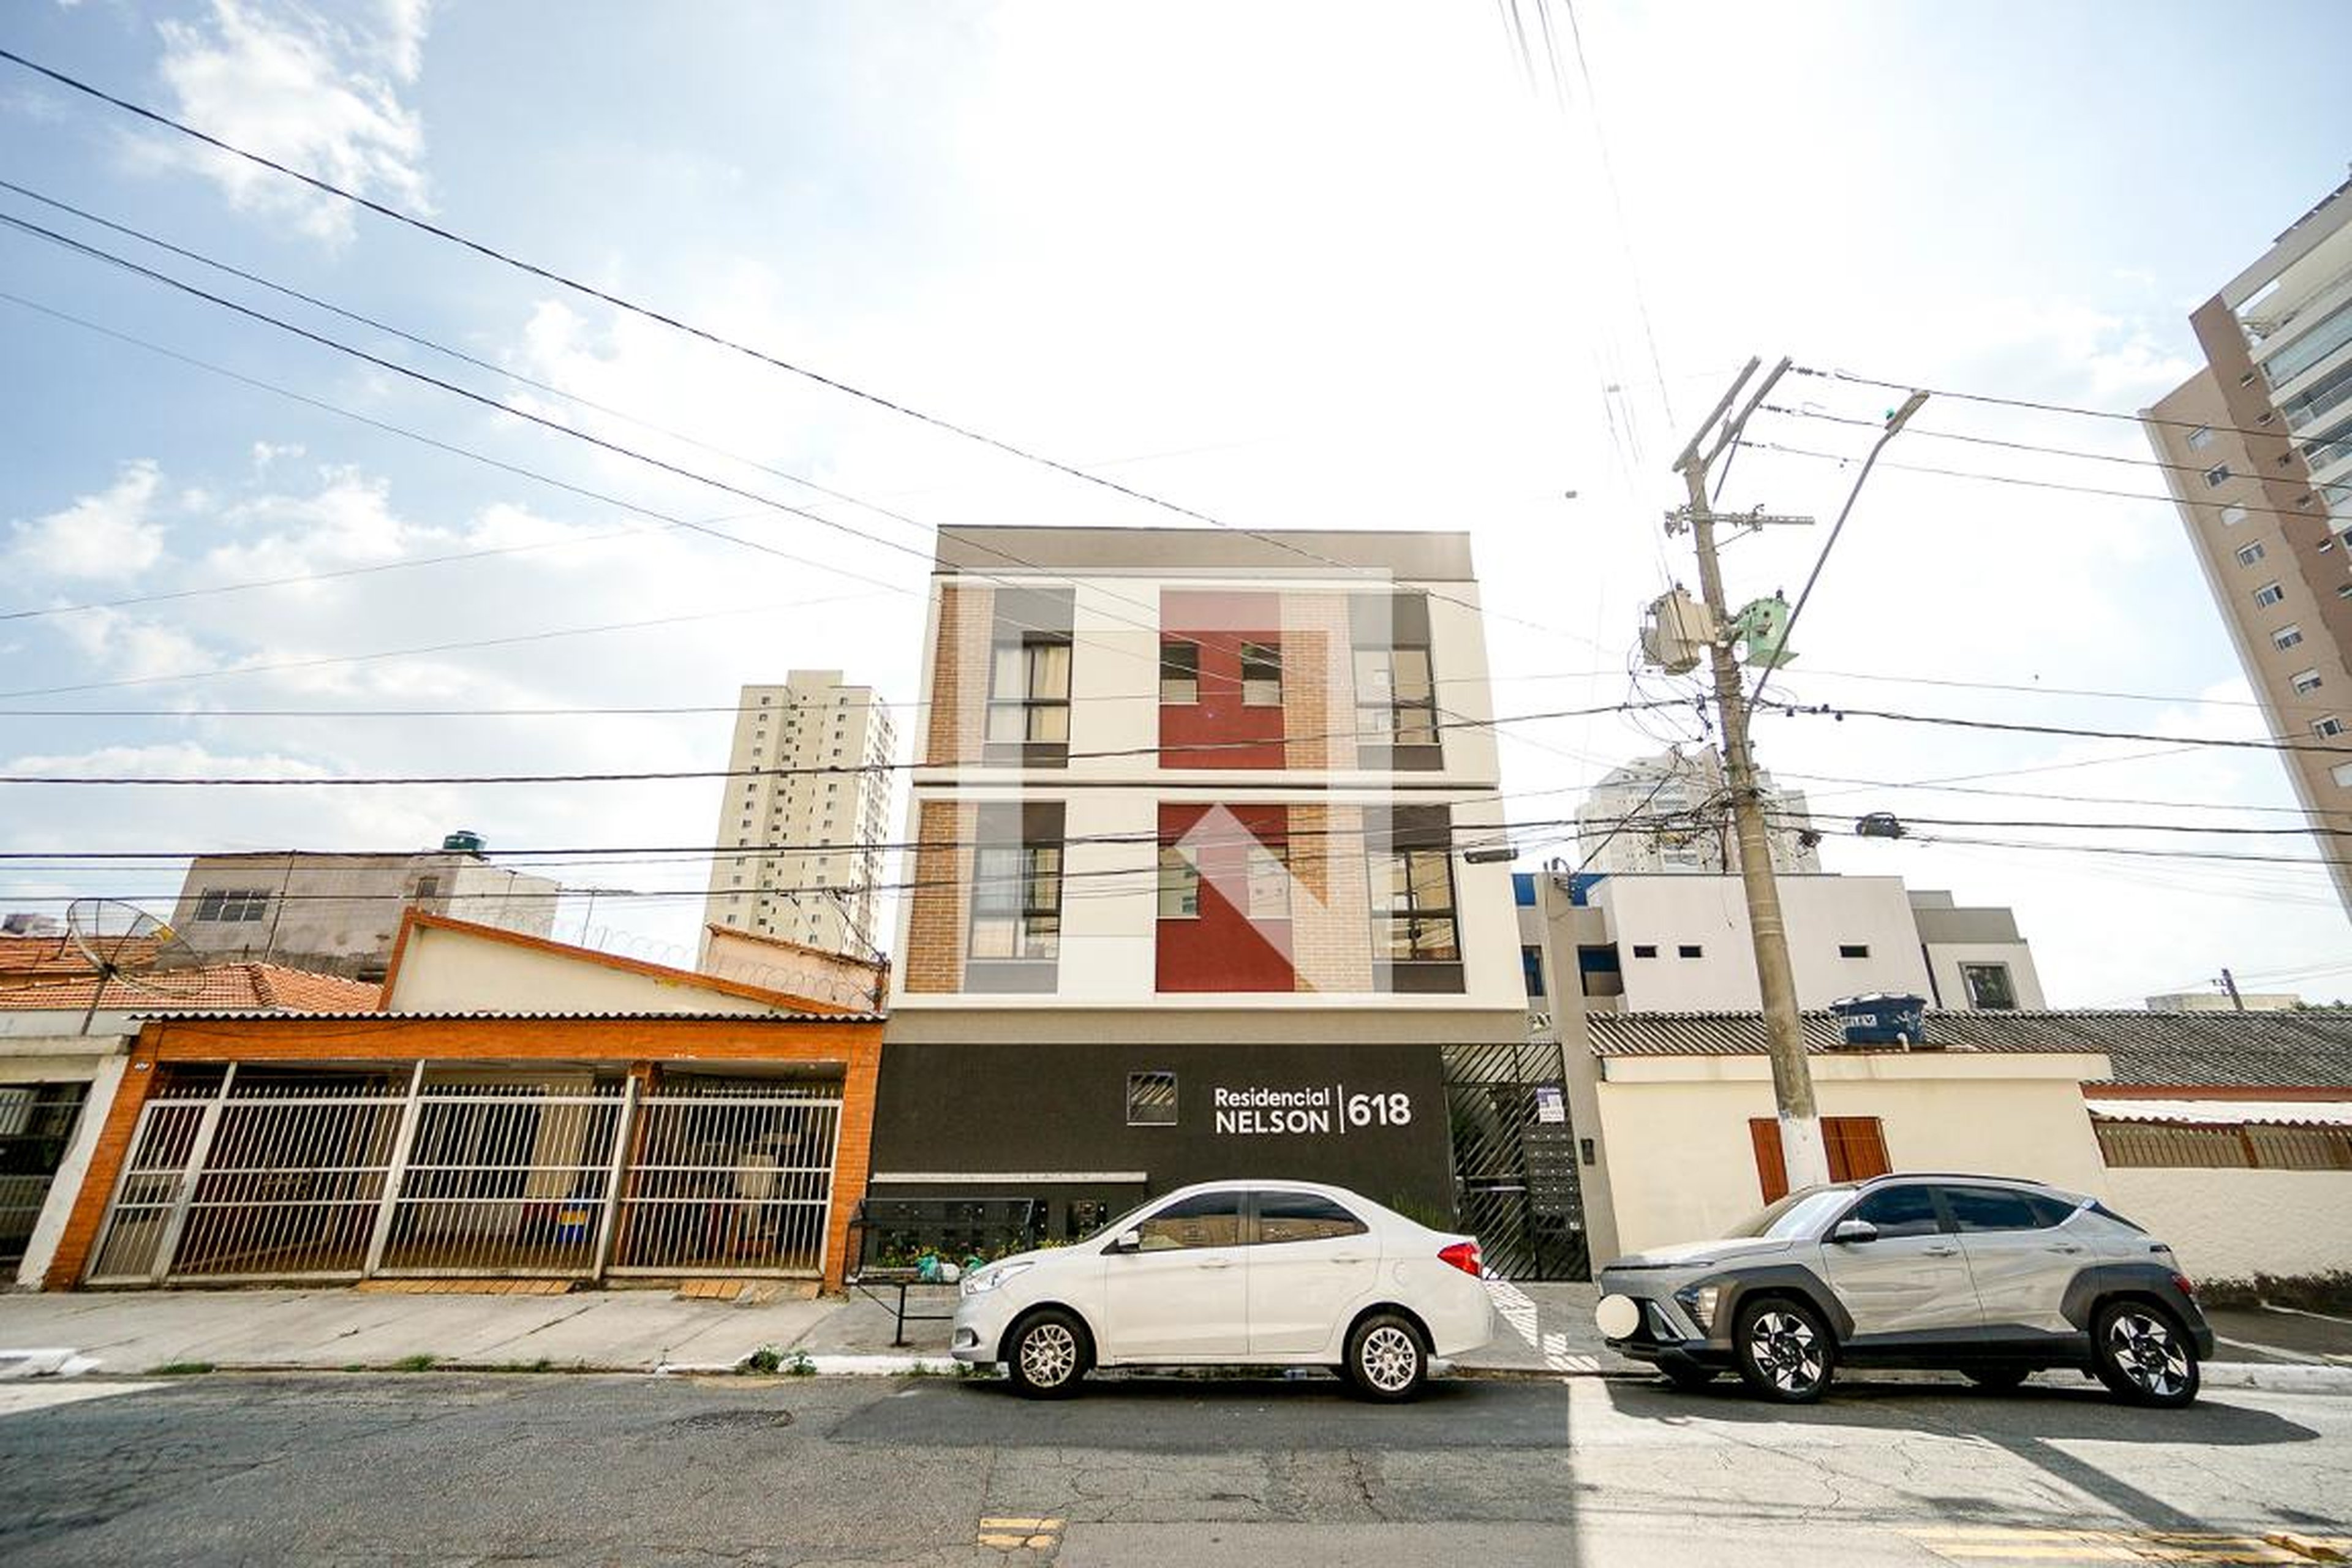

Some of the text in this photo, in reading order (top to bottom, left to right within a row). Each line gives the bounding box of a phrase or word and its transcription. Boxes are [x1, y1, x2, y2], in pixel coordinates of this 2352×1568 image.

[1215, 1087, 1329, 1106] Residencial
[1348, 1093, 1411, 1126] 618
[1216, 1110, 1329, 1133] NELSON
